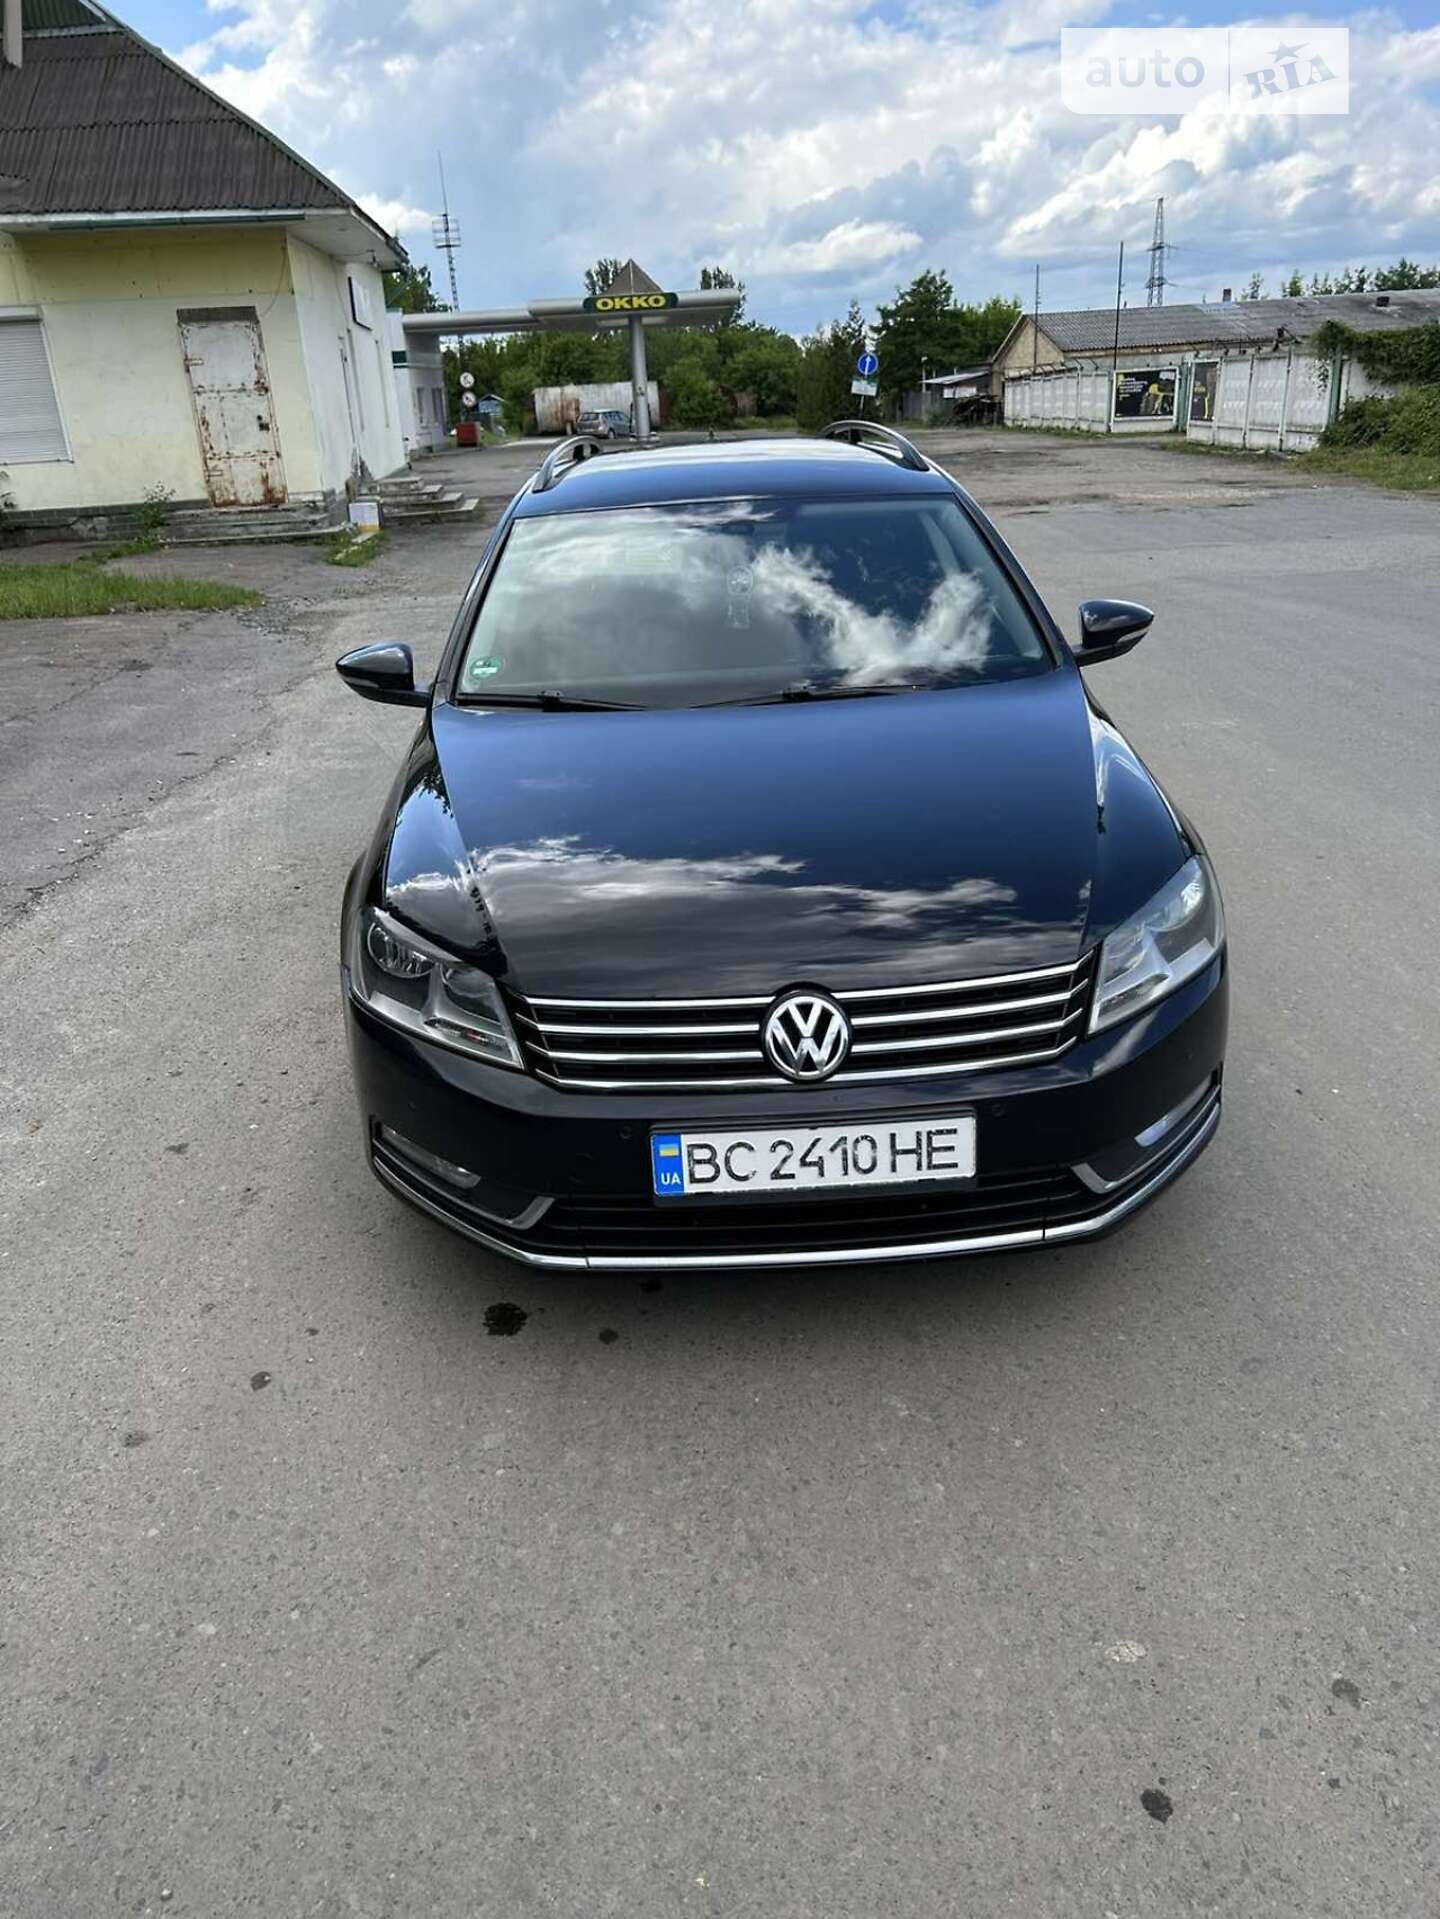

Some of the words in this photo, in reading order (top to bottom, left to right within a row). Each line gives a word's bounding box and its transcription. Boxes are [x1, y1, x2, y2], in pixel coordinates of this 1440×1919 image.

[596, 294, 666, 311] OKKO
[767, 997, 847, 1077] VW
[687, 1141, 757, 1185] BC
[769, 1134, 878, 1181] 2410
[890, 1127, 959, 1173] HE
[660, 1172, 681, 1186] UA
